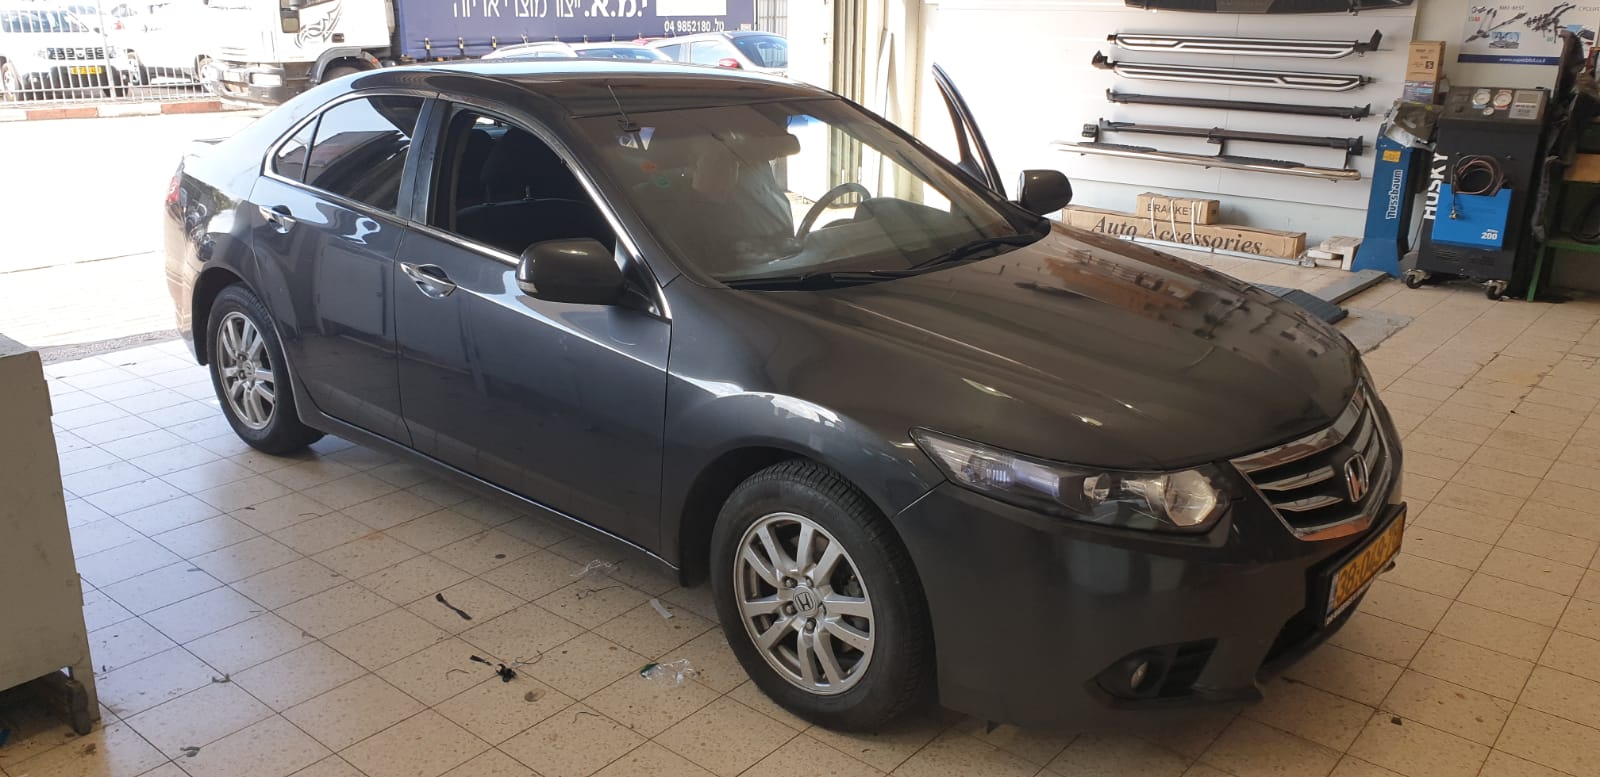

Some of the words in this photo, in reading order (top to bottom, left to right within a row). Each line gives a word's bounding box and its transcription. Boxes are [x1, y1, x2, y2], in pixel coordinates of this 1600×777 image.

[664, 21, 675, 32] 04
[677, 21, 711, 32] 9852180
[1423, 152, 1449, 220] HUSKY
[1147, 203, 1194, 216] BRAKE
[1092, 215, 1137, 237] Auto
[1144, 223, 1263, 254] Accessories
[1481, 232, 1498, 240] 200
